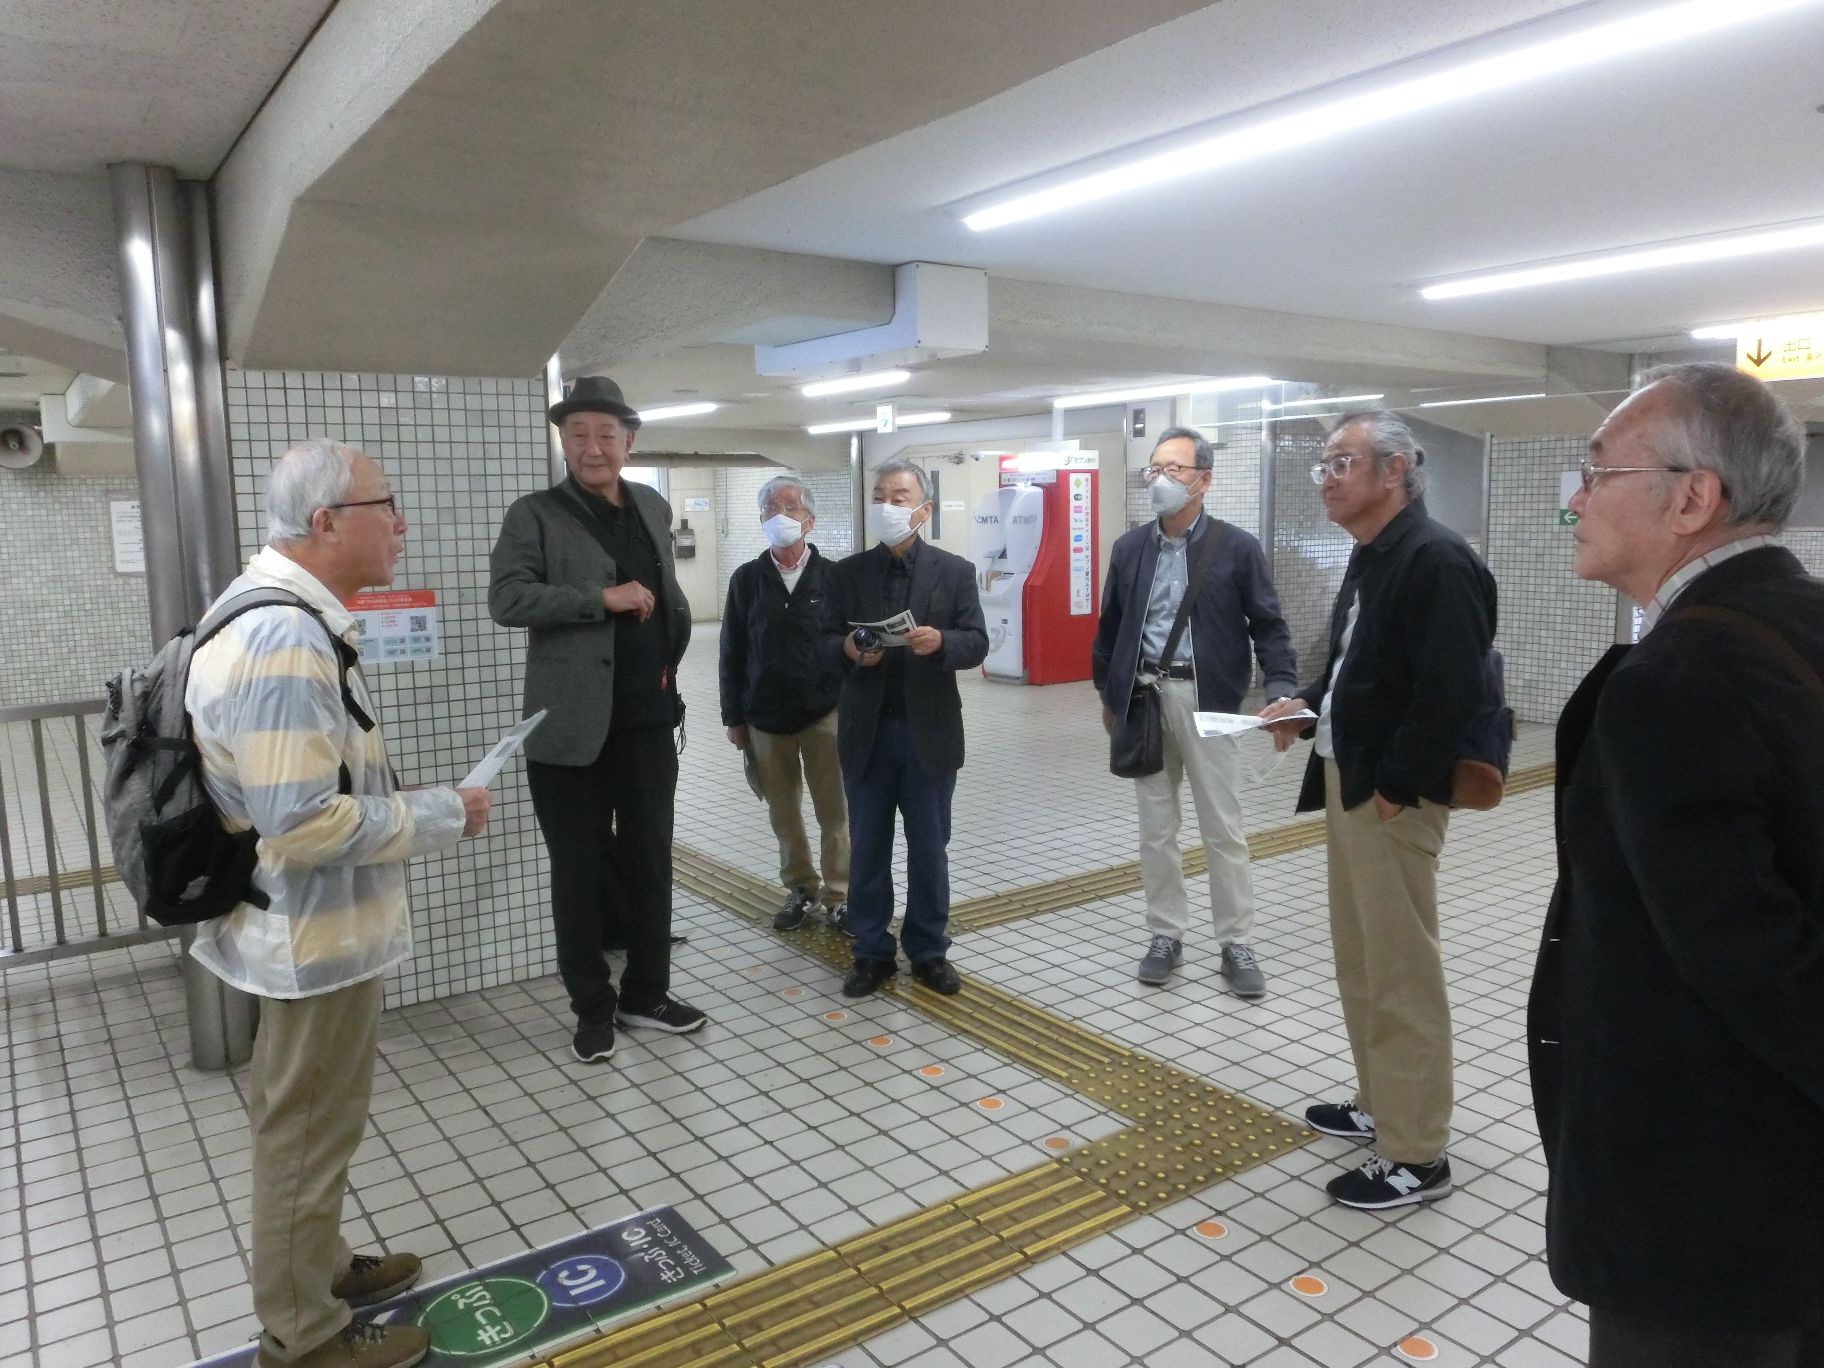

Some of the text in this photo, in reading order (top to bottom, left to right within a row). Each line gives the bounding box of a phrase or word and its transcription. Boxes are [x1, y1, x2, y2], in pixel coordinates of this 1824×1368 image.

[646, 1218, 671, 1237] Card
[664, 1236, 681, 1247] IC
[557, 1264, 607, 1297] IC
[451, 1285, 514, 1345] きっぷ
